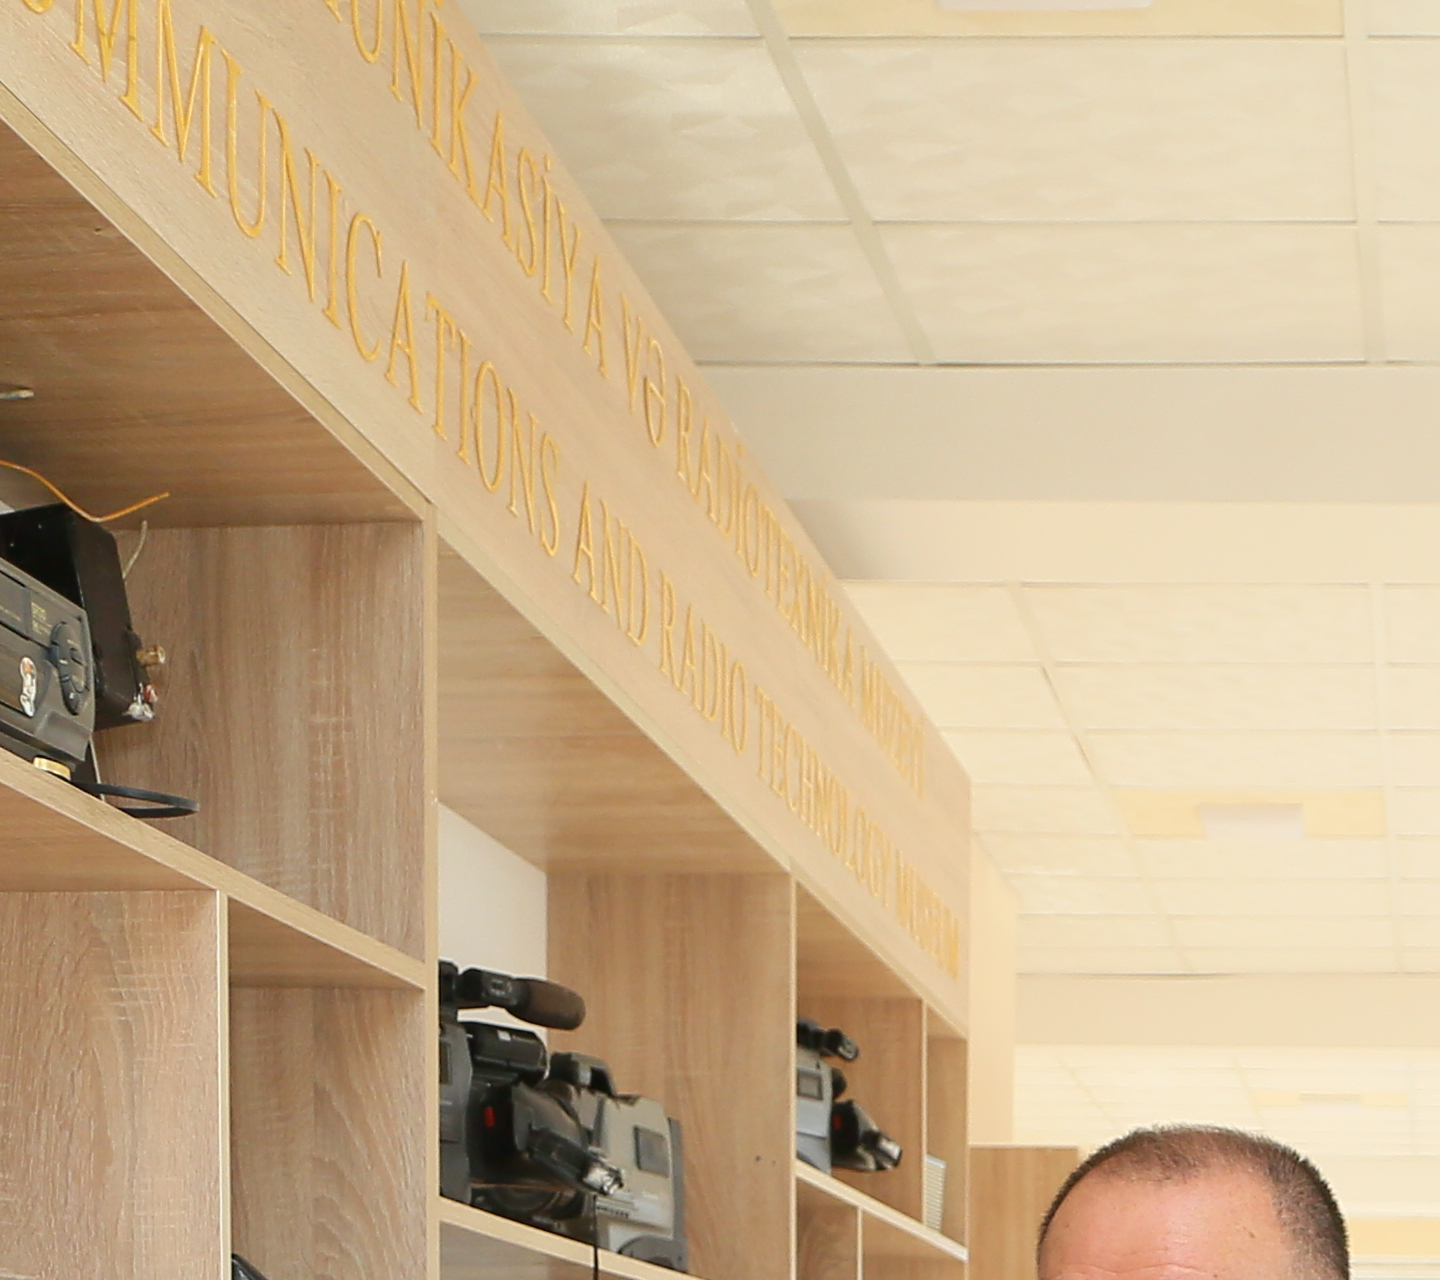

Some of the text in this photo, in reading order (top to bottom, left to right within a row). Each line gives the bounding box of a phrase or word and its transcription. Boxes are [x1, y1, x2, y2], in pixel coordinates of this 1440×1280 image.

[619, 292, 666, 447] VƏ
[571, 480, 649, 646] AND
[659, 569, 749, 755] RADIO
[754, 684, 892, 911] TECHNOLOGY
